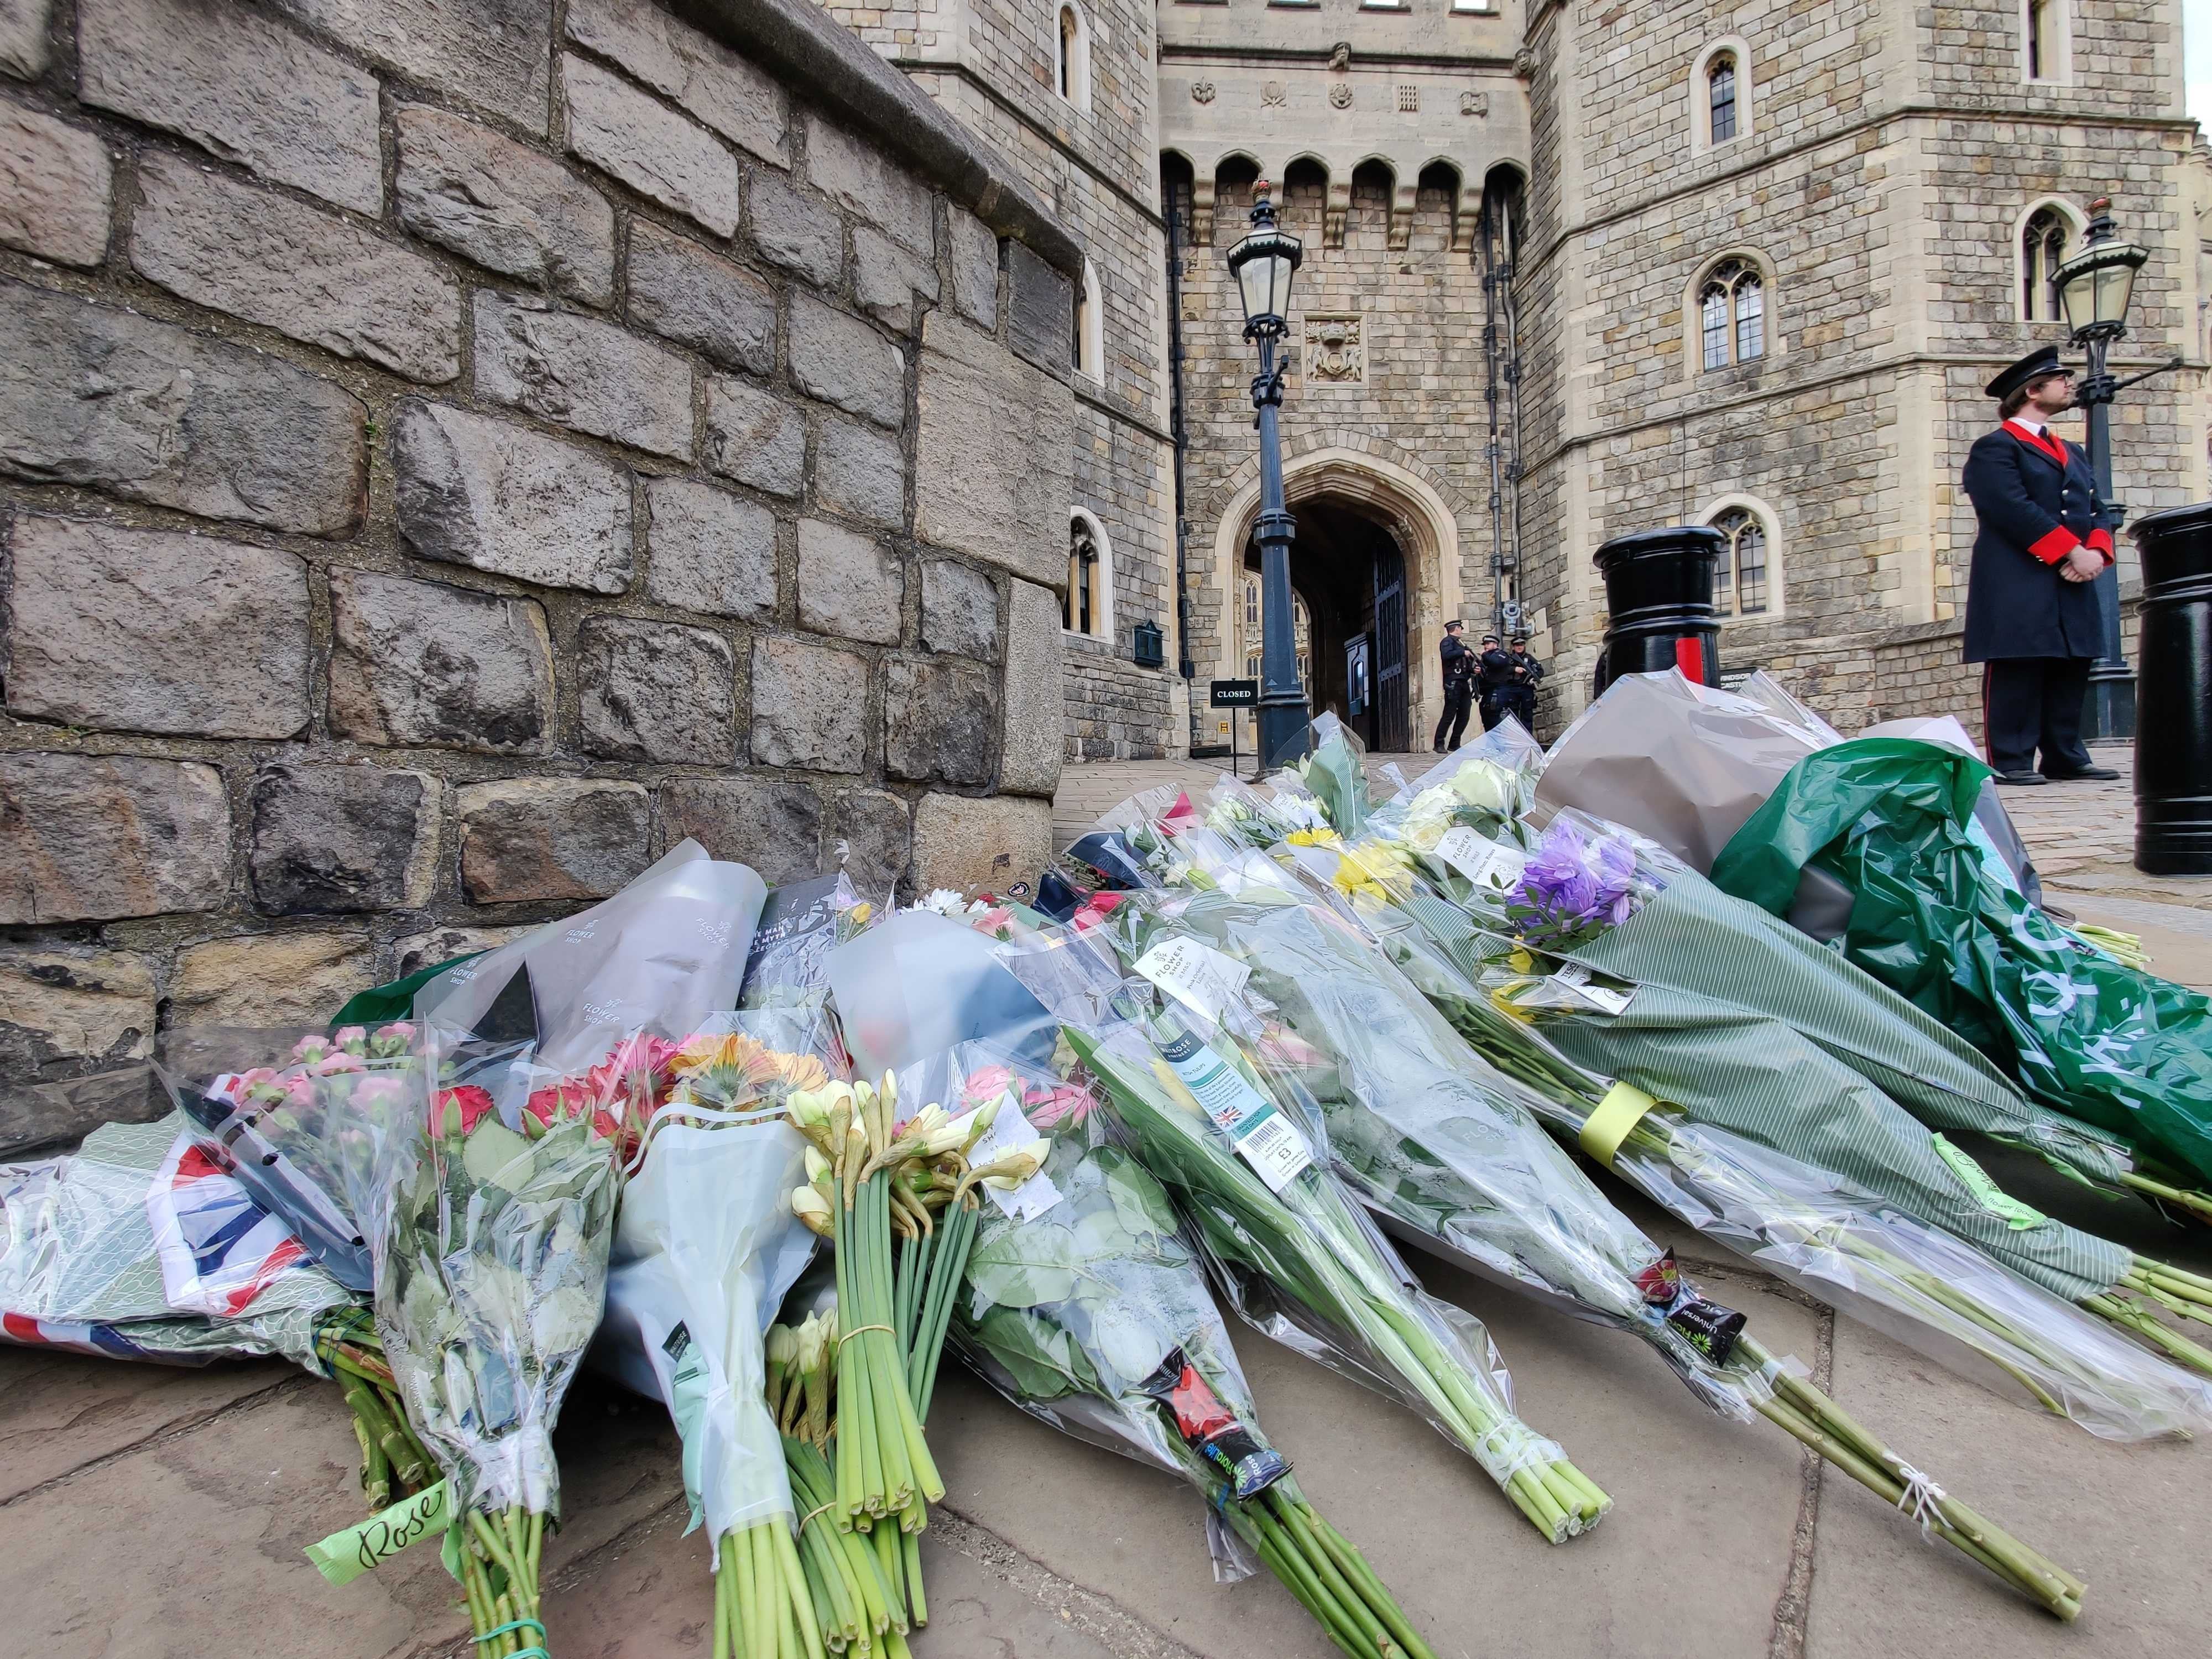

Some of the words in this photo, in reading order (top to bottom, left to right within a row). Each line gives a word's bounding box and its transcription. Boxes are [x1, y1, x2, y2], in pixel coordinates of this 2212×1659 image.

[1453, 834, 1472, 860] FLOWER
[566, 930, 595, 939] FLOWER
[695, 917, 730, 950] FLOWER
[697, 928, 717, 944] SHOP
[1155, 945, 1185, 978] FLOWER
[1169, 957, 1183, 976] SHOP
[450, 977, 466, 985] SHOP
[582, 1003, 620, 1022] FLOWER
[583, 1014, 603, 1025] SHOP
[1160, 1039, 1192, 1054] WAITROSE
[1279, 1147, 1291, 1160] £3
[1681, 1309, 1718, 1334] Universal
[1204, 1442, 1234, 1476] FloraLife
[1245, 1454, 1262, 1475] Rose
[358, 1490, 443, 1569] Rose
